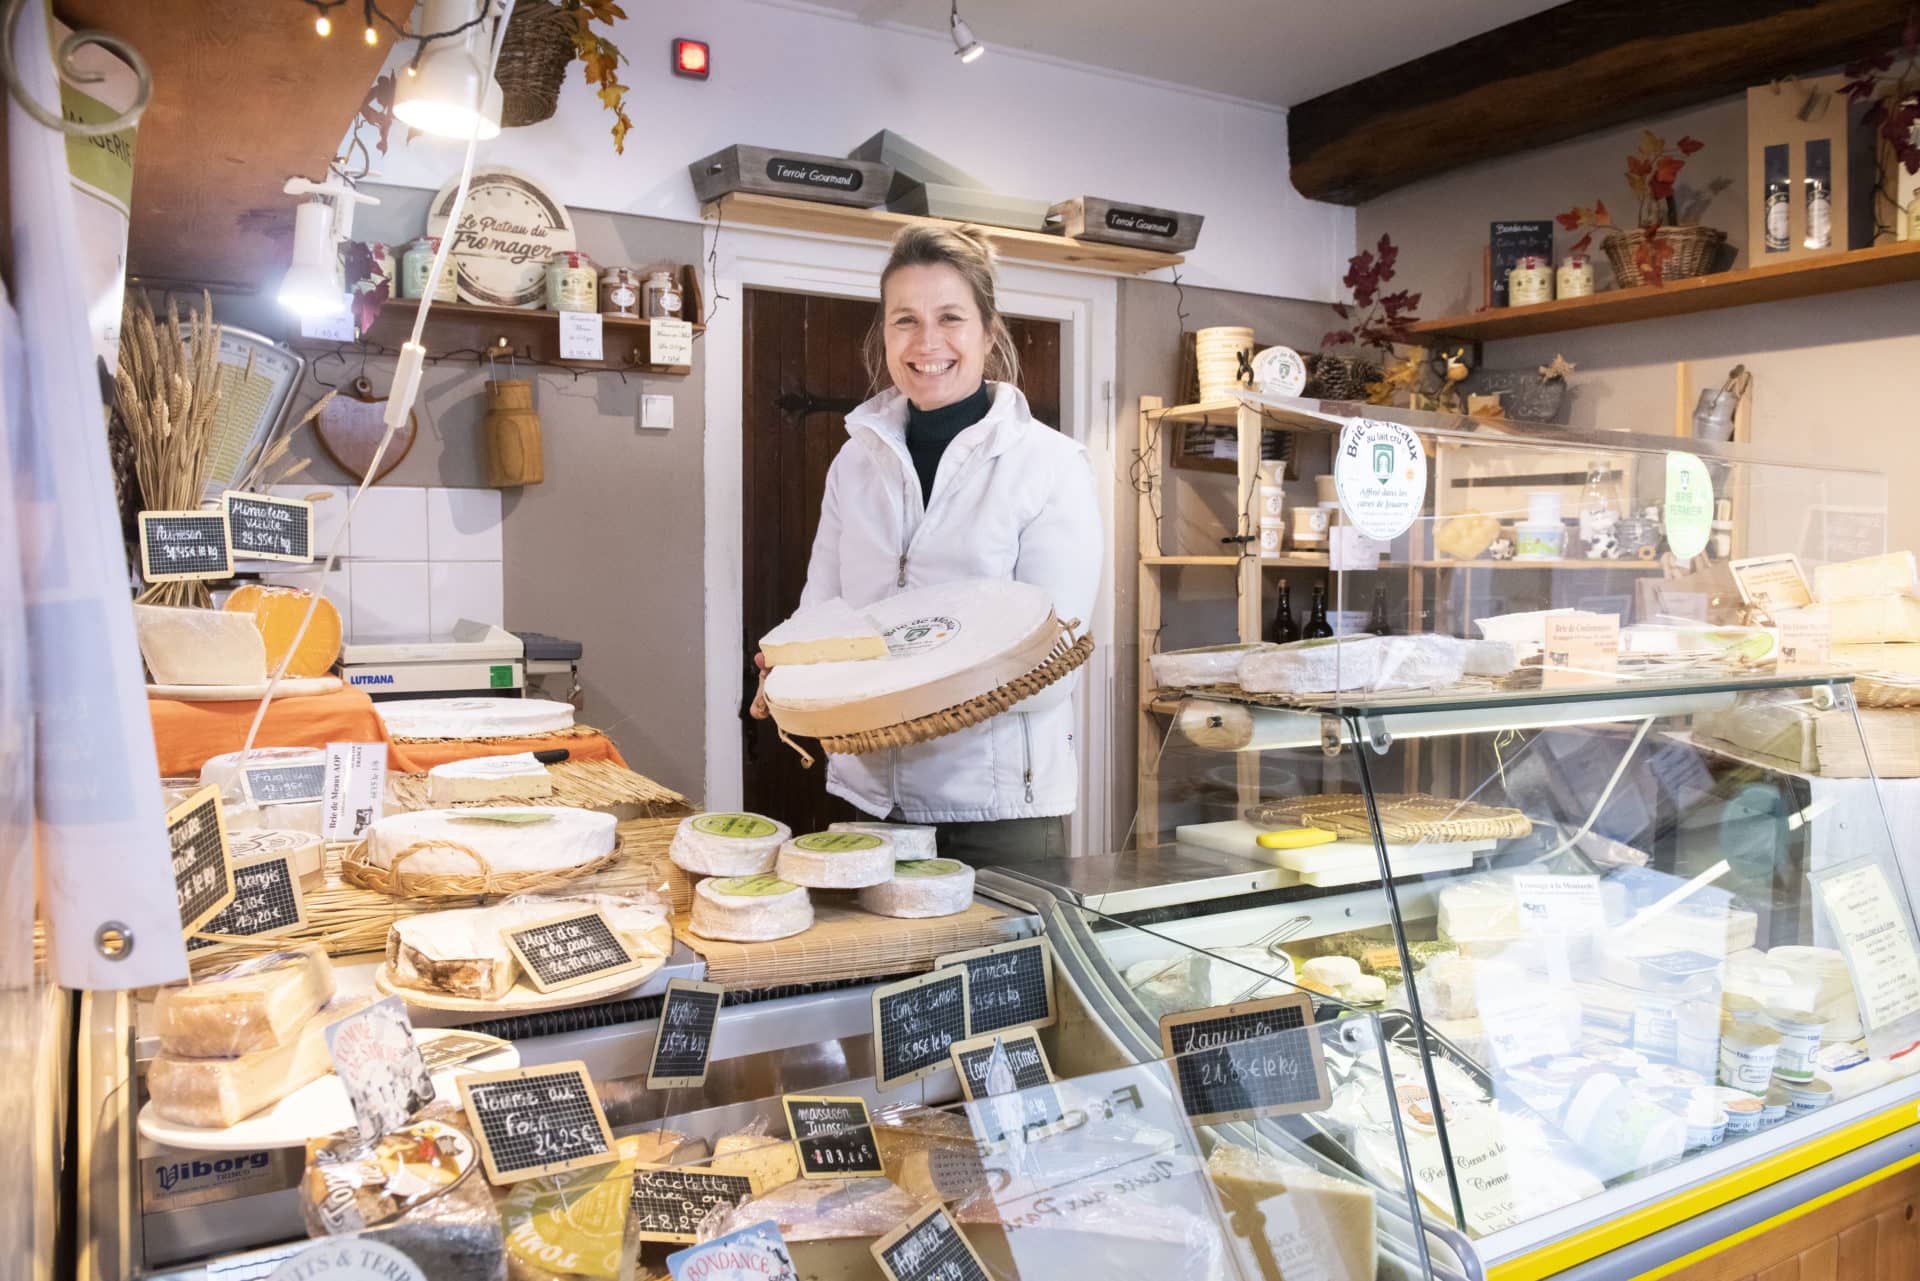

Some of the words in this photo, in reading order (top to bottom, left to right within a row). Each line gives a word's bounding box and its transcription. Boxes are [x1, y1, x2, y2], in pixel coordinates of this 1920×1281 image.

[777, 165, 807, 179] Terroir
[809, 169, 854, 185] Gourmand
[457, 213, 478, 230] Le
[479, 216, 529, 236] Plateau
[530, 223, 549, 238] du
[450, 230, 553, 264] Fromager
[1346, 424, 1366, 458] Brie
[350, 674, 394, 685] LUTRANA
[333, 754, 342, 774] AOP
[331, 775, 341, 800] Meaux
[330, 801, 338, 811] de
[329, 814, 338, 829] Brie
[1278, 1055, 1298, 1081] kg
[548, 1087, 575, 1101] au
[155, 1151, 269, 1191] Viborg
[702, 1194, 724, 1204] ou
[335, 1249, 352, 1268] &
